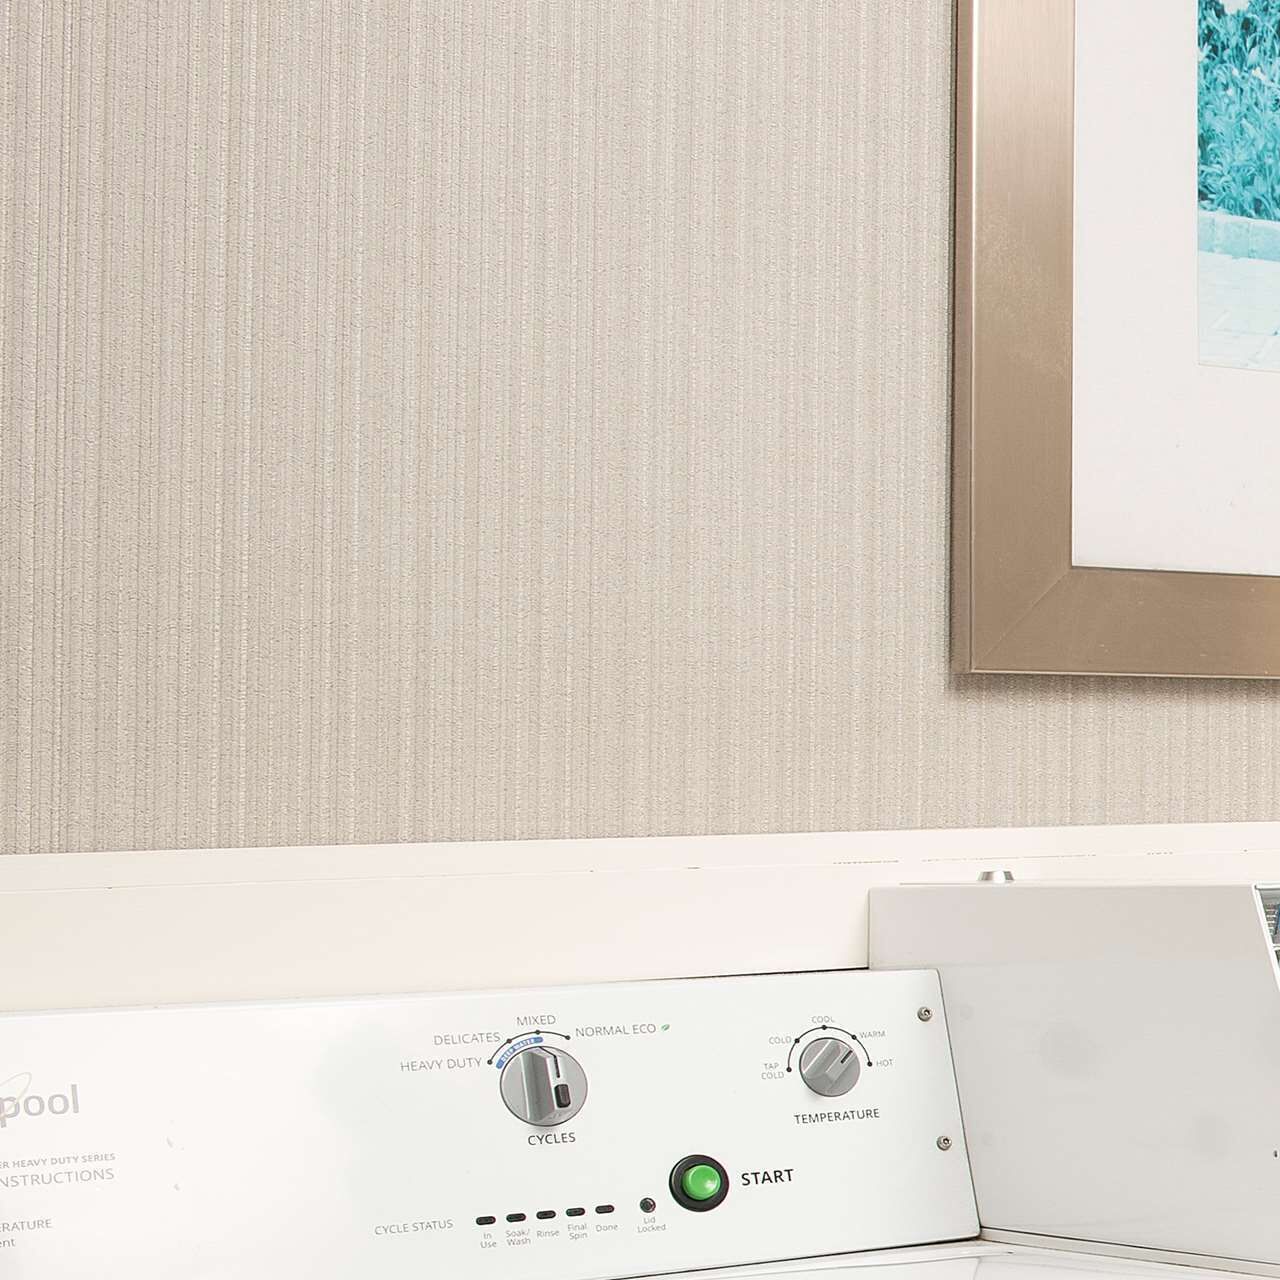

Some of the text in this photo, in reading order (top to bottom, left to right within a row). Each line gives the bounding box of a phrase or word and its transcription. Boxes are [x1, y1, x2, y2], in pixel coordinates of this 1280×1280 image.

[516, 1014, 557, 1027] MIXED
[575, 1023, 656, 1038] NORMAL ECO
[860, 1030, 886, 1039] WARM
[433, 1031, 501, 1046] DELICATES
[768, 1035, 792, 1045] COLD
[400, 1057, 482, 1073] HEAVY DUTY
[764, 1062, 779, 1071] TAP
[876, 1058, 893, 1067] HOT
[761, 1071, 784, 1080] COLD
[794, 1108, 880, 1125] TEMPERATURE
[527, 1131, 576, 1146] CYCLES
[12, 1158, 48, 1169] HEAVY
[51, 1155, 80, 1166] DUTY
[81, 1152, 116, 1164] SERIES
[740, 1168, 794, 1187] START
[0, 1218, 53, 1233] RATURE
[643, 1216, 656, 1225] Lid
[374, 1218, 455, 1236] CYCLE STATUS
[567, 1222, 588, 1232] Final
[595, 1222, 619, 1233] Done
[637, 1223, 667, 1234] Locked
[536, 1229, 560, 1239] Rinse
[569, 1231, 588, 1241] Spin
[480, 1240, 497, 1249] Use
[506, 1237, 531, 1247] Wash
